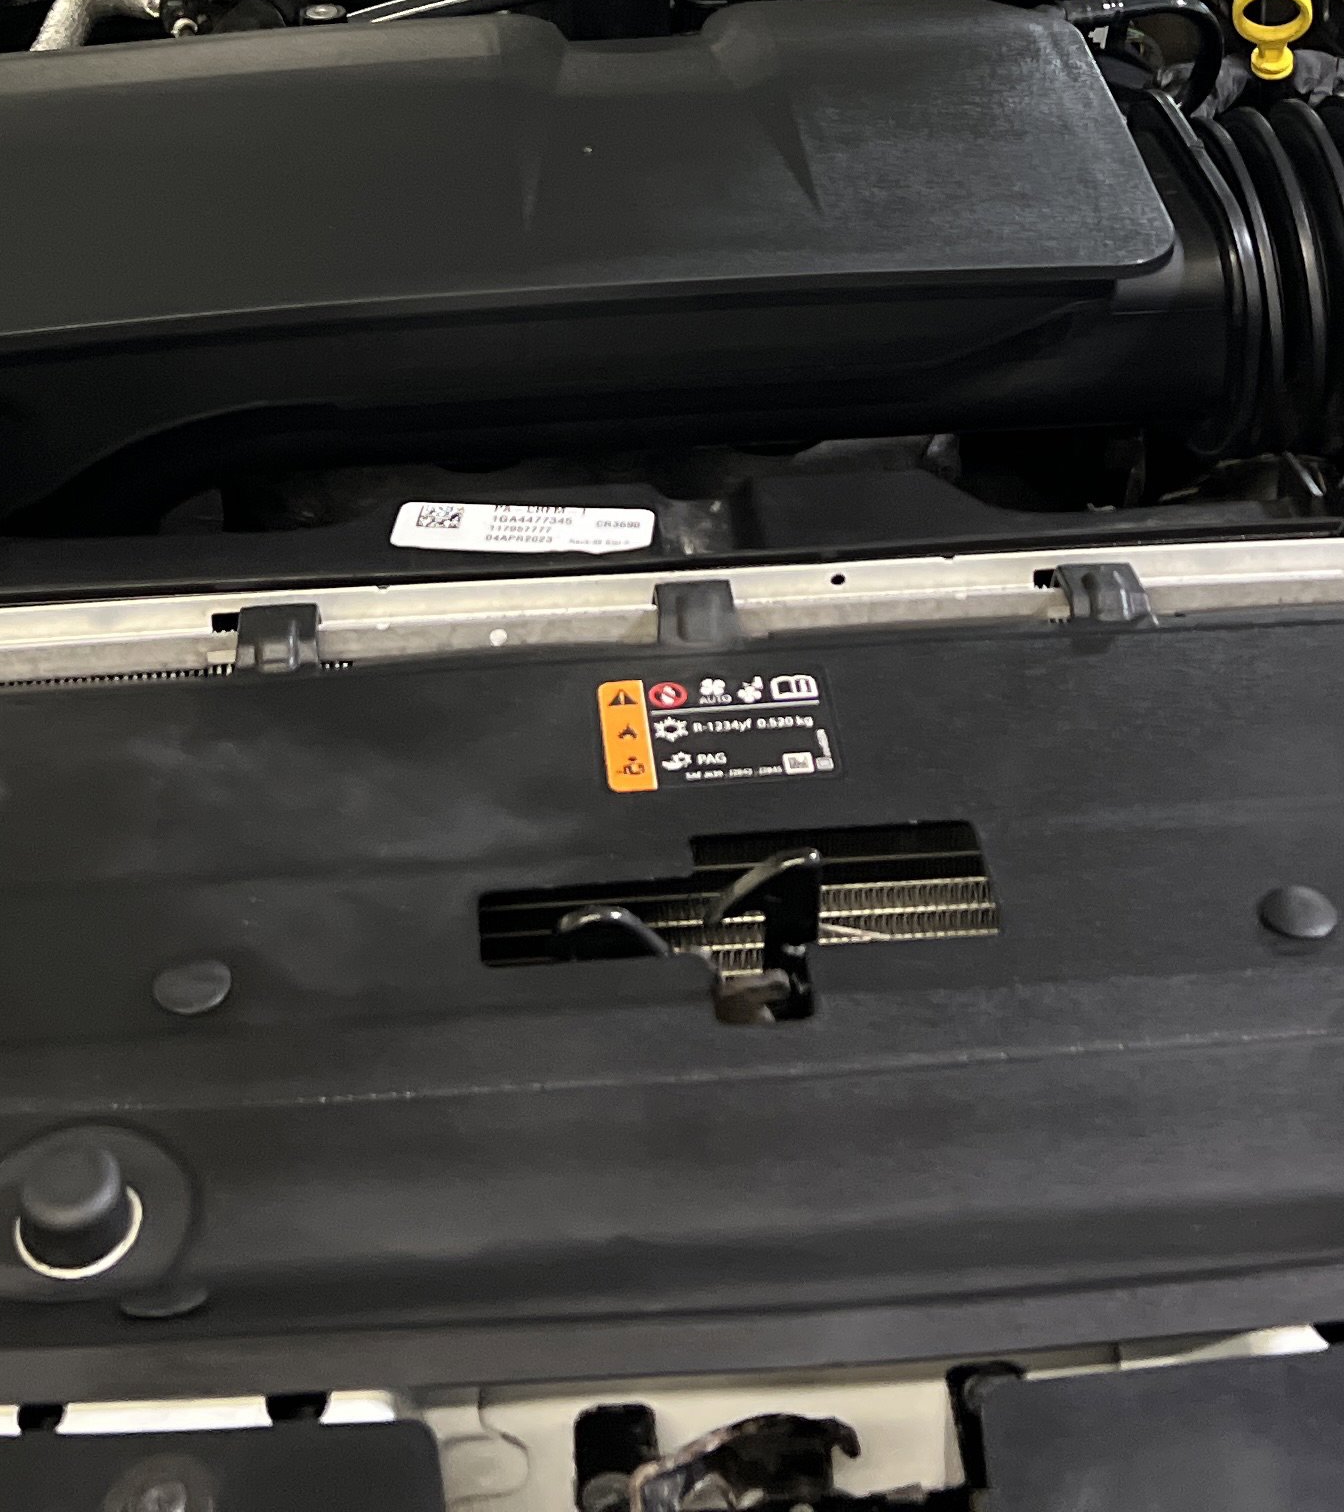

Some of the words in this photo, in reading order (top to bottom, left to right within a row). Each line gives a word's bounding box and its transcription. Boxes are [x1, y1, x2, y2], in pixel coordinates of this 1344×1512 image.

[699, 694, 732, 705] AUTO
[692, 718, 752, 733] R-1234yf
[795, 715, 813, 729] kg
[696, 752, 727, 765] PAG
